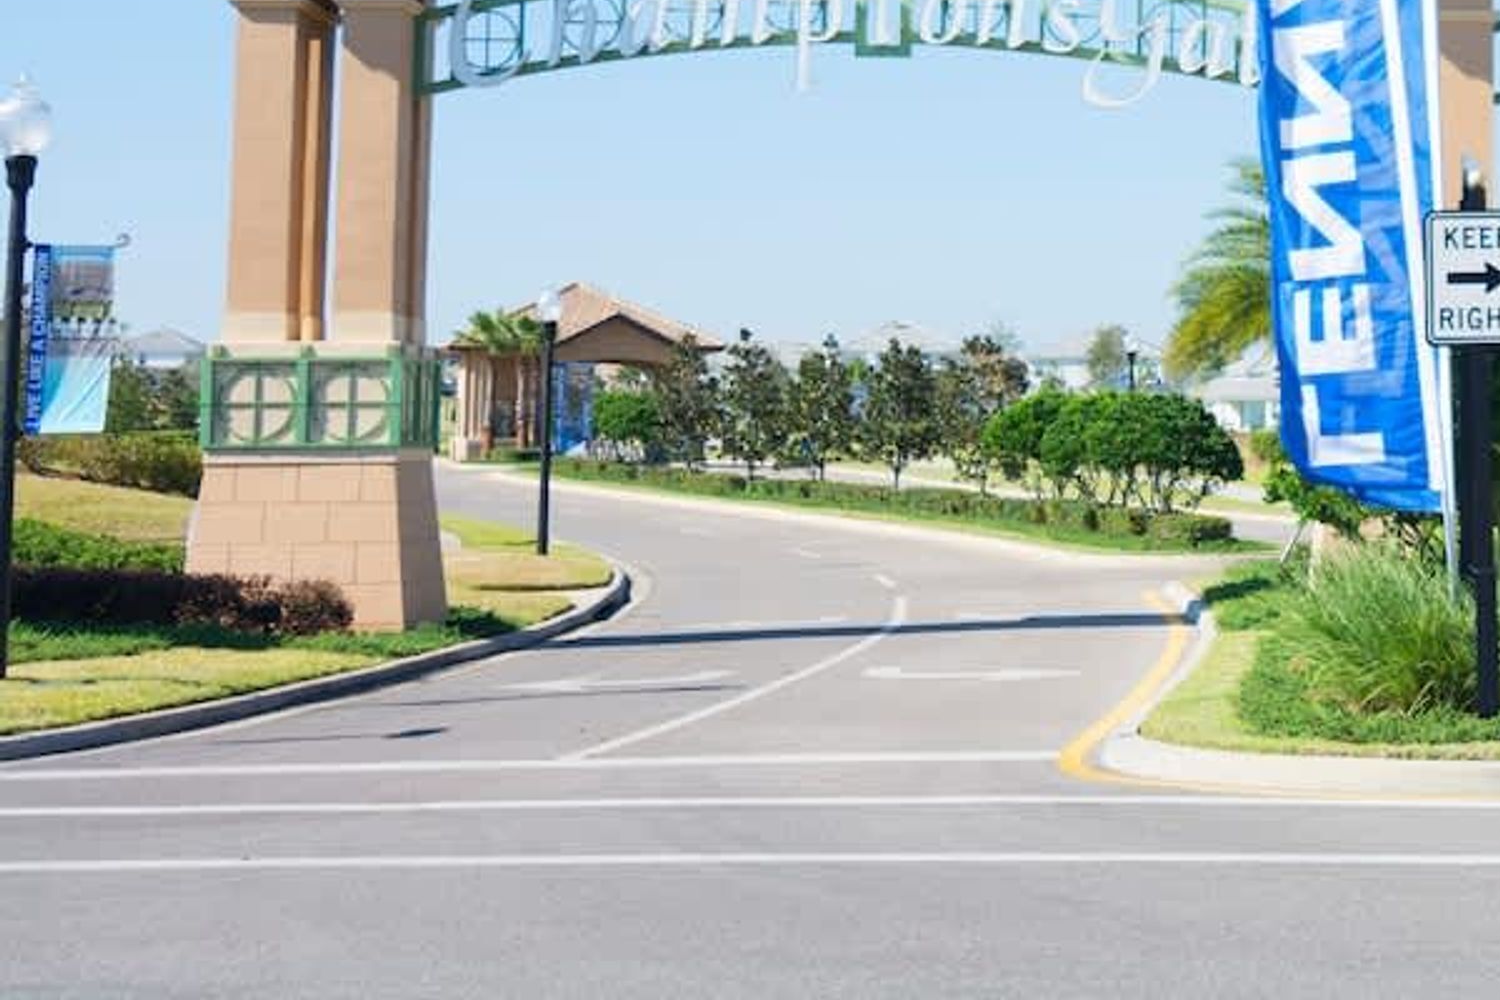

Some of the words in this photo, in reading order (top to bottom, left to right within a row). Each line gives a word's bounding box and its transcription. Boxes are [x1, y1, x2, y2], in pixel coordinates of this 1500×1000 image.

[32, 252, 49, 336] CHAMPION
[28, 355, 44, 389] LIKE
[26, 395, 42, 428] LIVE
